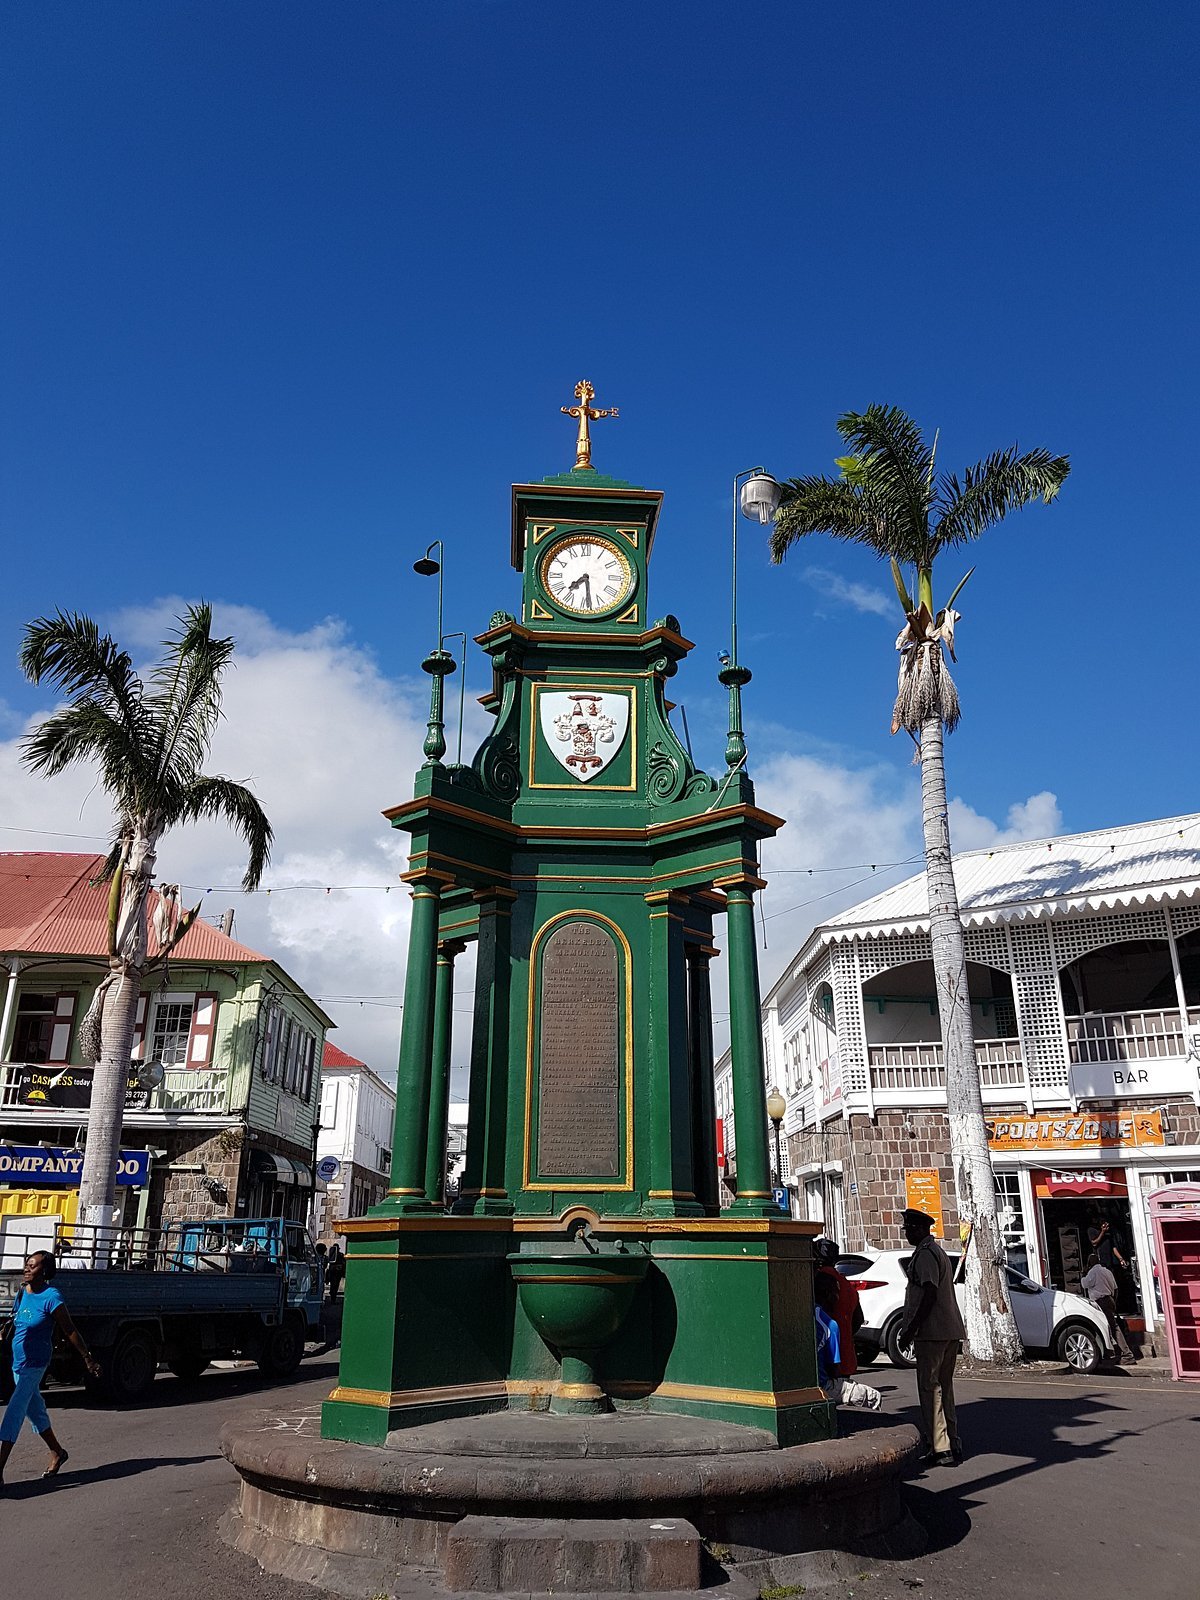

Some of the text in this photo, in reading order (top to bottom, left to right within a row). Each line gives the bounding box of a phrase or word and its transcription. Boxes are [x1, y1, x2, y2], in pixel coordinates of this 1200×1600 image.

[555, 949, 608, 957] MEMORIAL
[1113, 1069, 1149, 1084] BAR
[73, 1078, 91, 1087] today
[133, 1091, 148, 1099] 2729
[0, 1156, 83, 1173] OMPANY
[775, 1190, 784, 1203] P
